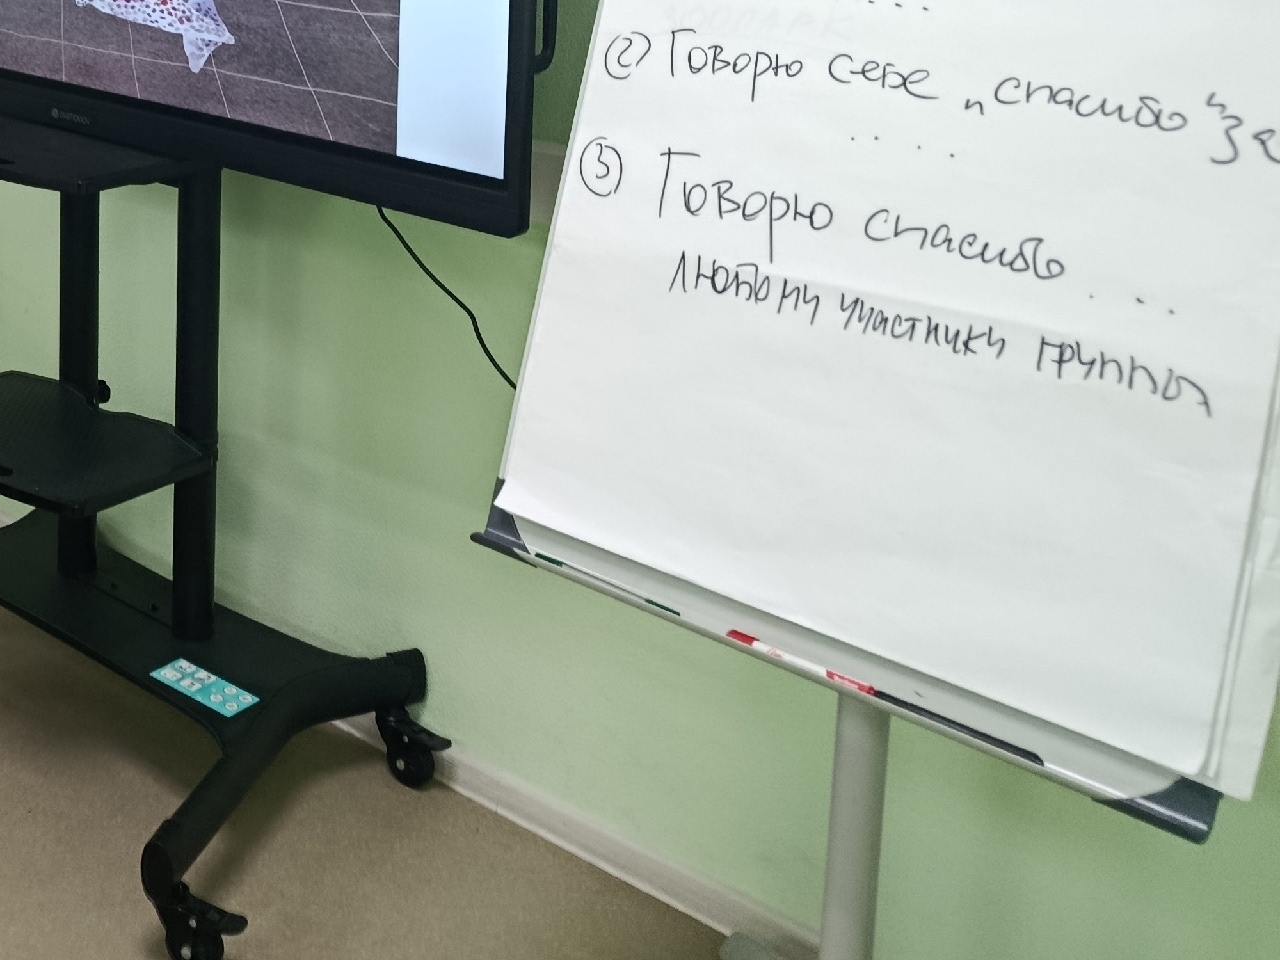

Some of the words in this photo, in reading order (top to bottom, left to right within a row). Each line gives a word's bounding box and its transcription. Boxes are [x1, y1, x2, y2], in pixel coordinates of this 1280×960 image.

[671, 28, 803, 103] Говорю
[660, 146, 834, 265] Говорю
[864, 209, 1065, 280] спасибо
